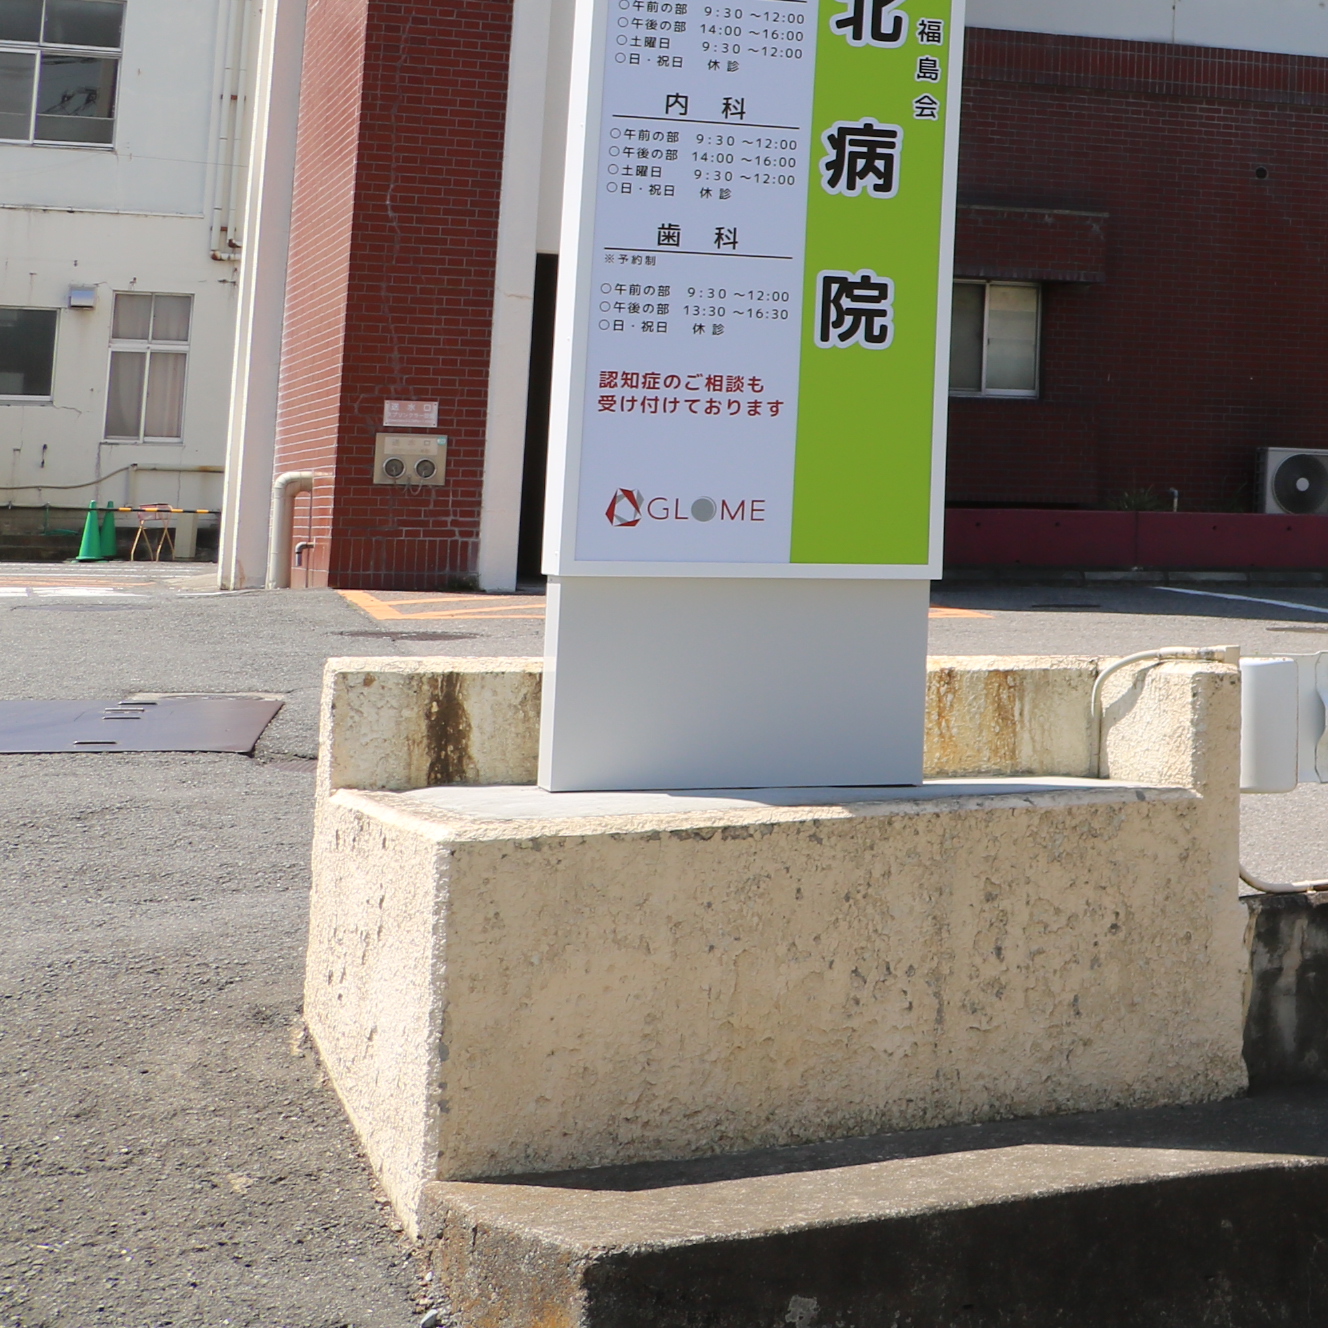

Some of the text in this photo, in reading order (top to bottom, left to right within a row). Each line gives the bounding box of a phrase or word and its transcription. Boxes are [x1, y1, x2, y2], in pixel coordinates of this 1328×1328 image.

[707, 59, 740, 73] 休診
[914, 19, 943, 119] 福島会
[665, 92, 746, 120] 内科
[699, 187, 732, 200] 休診
[657, 223, 739, 250] 歯科
[692, 323, 725, 336] 休診
[598, 371, 765, 394] 認知症のご相談も
[597, 395, 785, 417] 受け付けております
